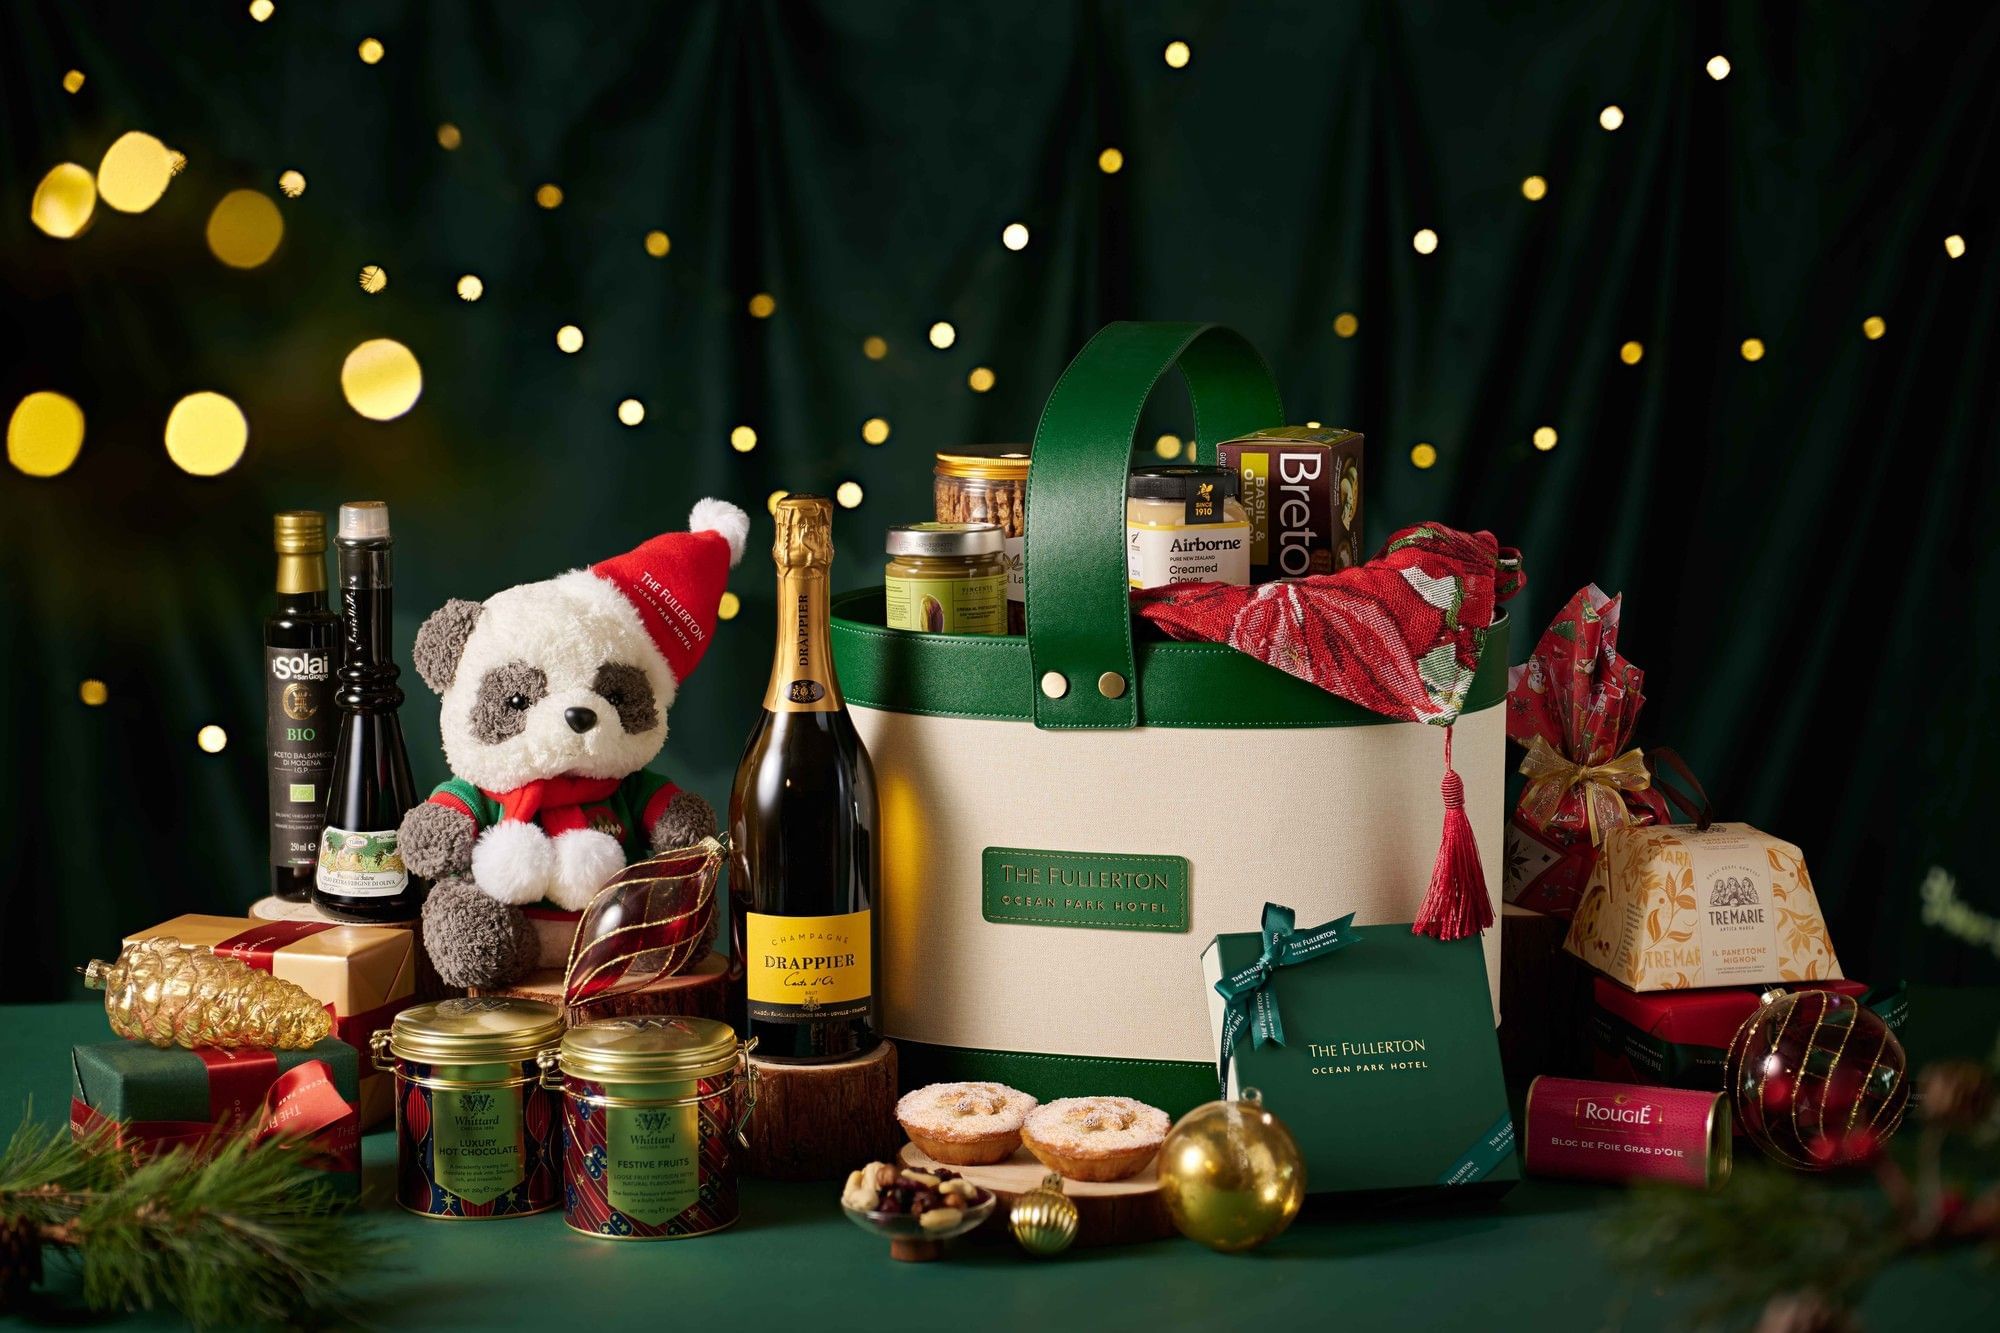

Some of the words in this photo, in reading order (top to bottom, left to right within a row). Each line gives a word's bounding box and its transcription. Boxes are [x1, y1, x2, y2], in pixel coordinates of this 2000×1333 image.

[1256, 477, 1265, 524] BASIL
[1280, 453, 1321, 581] Breto
[1170, 537, 1241, 552] Airborne
[1256, 532, 1265, 542] &
[1170, 563, 1217, 574] Creamed
[641, 571, 661, 592] THE
[660, 588, 705, 641] FULLERTON
[633, 584, 657, 606] OCEAN
[658, 607, 673, 626] PARK
[673, 626, 692, 650] HOTEL
[799, 594, 808, 666] DRAPPIER
[287, 728, 315, 741] BIO
[1001, 864, 1040, 885] THE
[1048, 867, 1168, 890] FULLERTON
[1001, 895, 1056, 908] OCEAN
[1065, 900, 1105, 910] PARK
[1114, 901, 1168, 913] HOTEL
[1709, 909, 1765, 926] TREMARIE
[772, 933, 848, 946] CHAMPAGNE
[1303, 930, 1336, 946] FULLERTON
[1645, 946, 1700, 968] TREMAR
[1722, 947, 1767, 956] PANETTONE
[765, 954, 855, 970] DRAPPIER
[784, 972, 806, 987] Carte
[1257, 992, 1266, 1026] FULLERTON
[1308, 1044, 1338, 1057] THE
[1342, 1039, 1425, 1055] FULLERTON
[1312, 1066, 1351, 1075] OCEAN
[1356, 1064, 1385, 1072] PARK
[1391, 1061, 1428, 1070] HOTEL
[280, 1104, 301, 1122] THE
[455, 1115, 499, 1126] Whittard
[631, 1134, 675, 1144] Whittard
[1551, 1137, 1578, 1147] BLOC
[1598, 1142, 1620, 1151] FOIE
[1624, 1144, 1652, 1154] GRAS
[461, 1146, 518, 1156] CHOCOLATE
[618, 1160, 655, 1168] FESTIVE
[658, 1158, 689, 1168] FRUITS
[1448, 1160, 1474, 1185] FULLERTON
